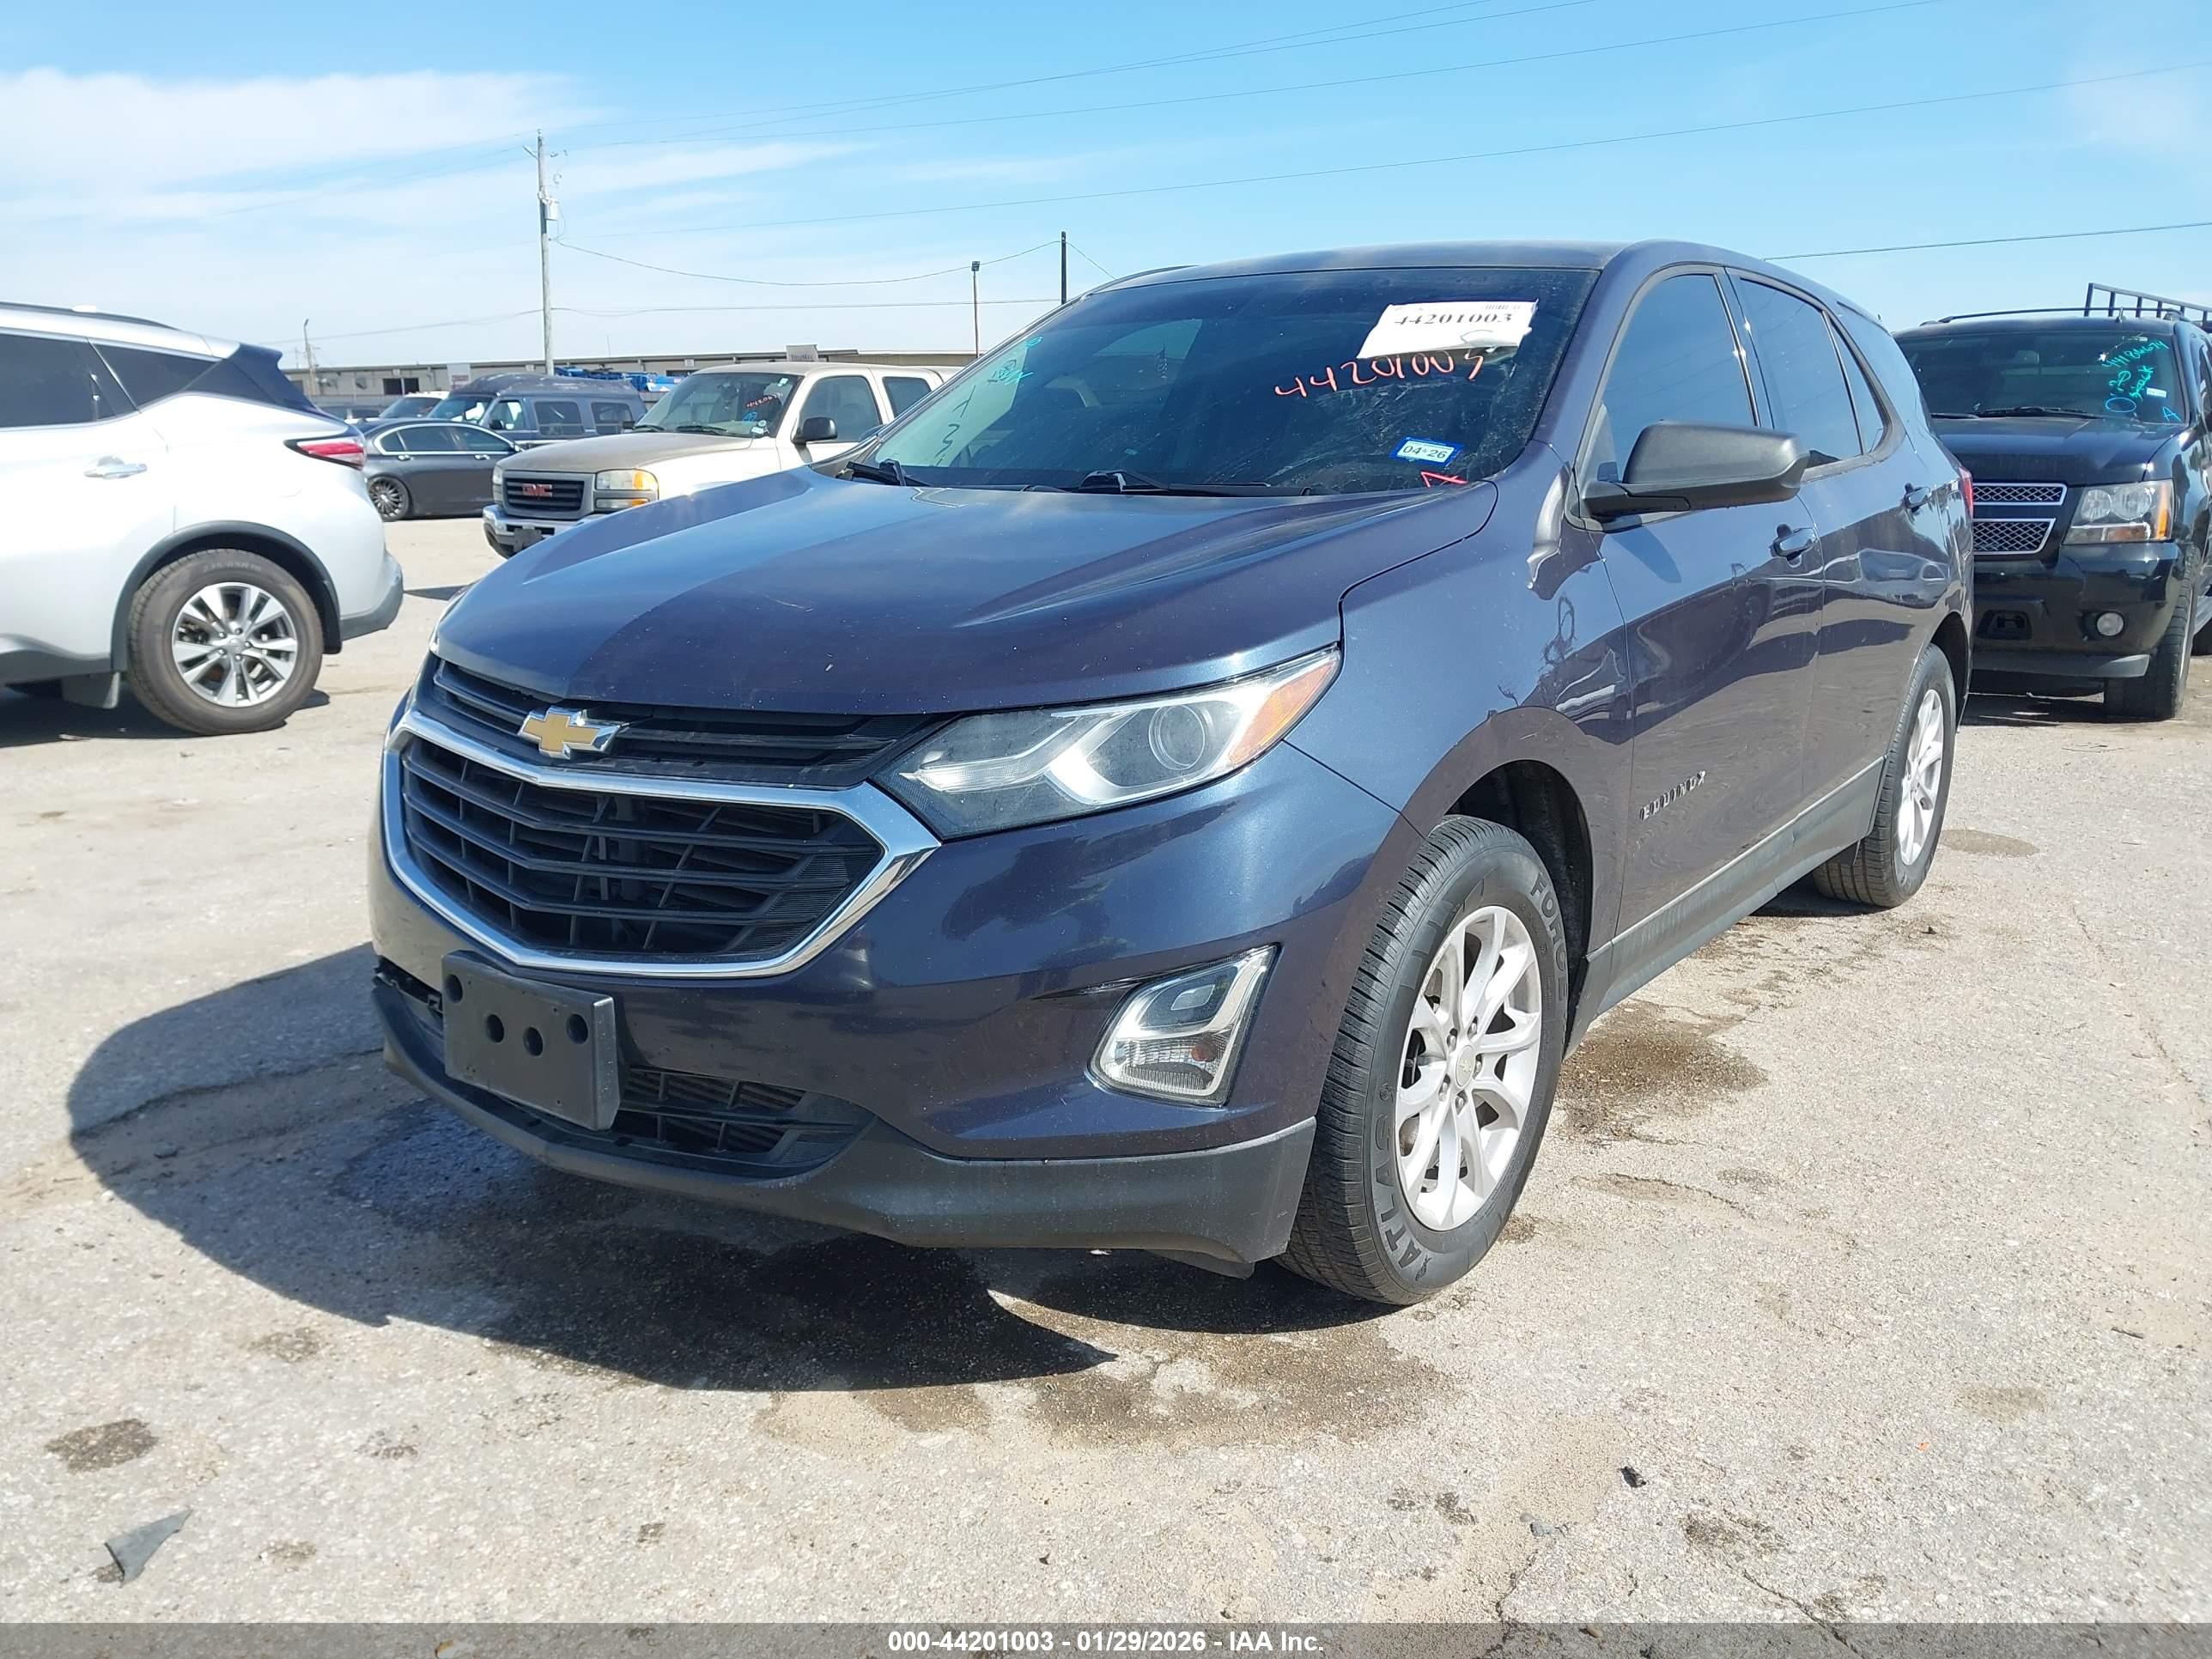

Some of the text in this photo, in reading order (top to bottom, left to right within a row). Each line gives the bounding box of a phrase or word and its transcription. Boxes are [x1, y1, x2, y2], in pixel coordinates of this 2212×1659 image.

[1394, 313, 1513, 325] 44201003
[522, 483, 552, 497] GMC
[1639, 770, 1706, 821] EQUINOX
[1529, 871, 1569, 1003] FORCE
[1375, 1114, 1422, 1269] ATLAS
